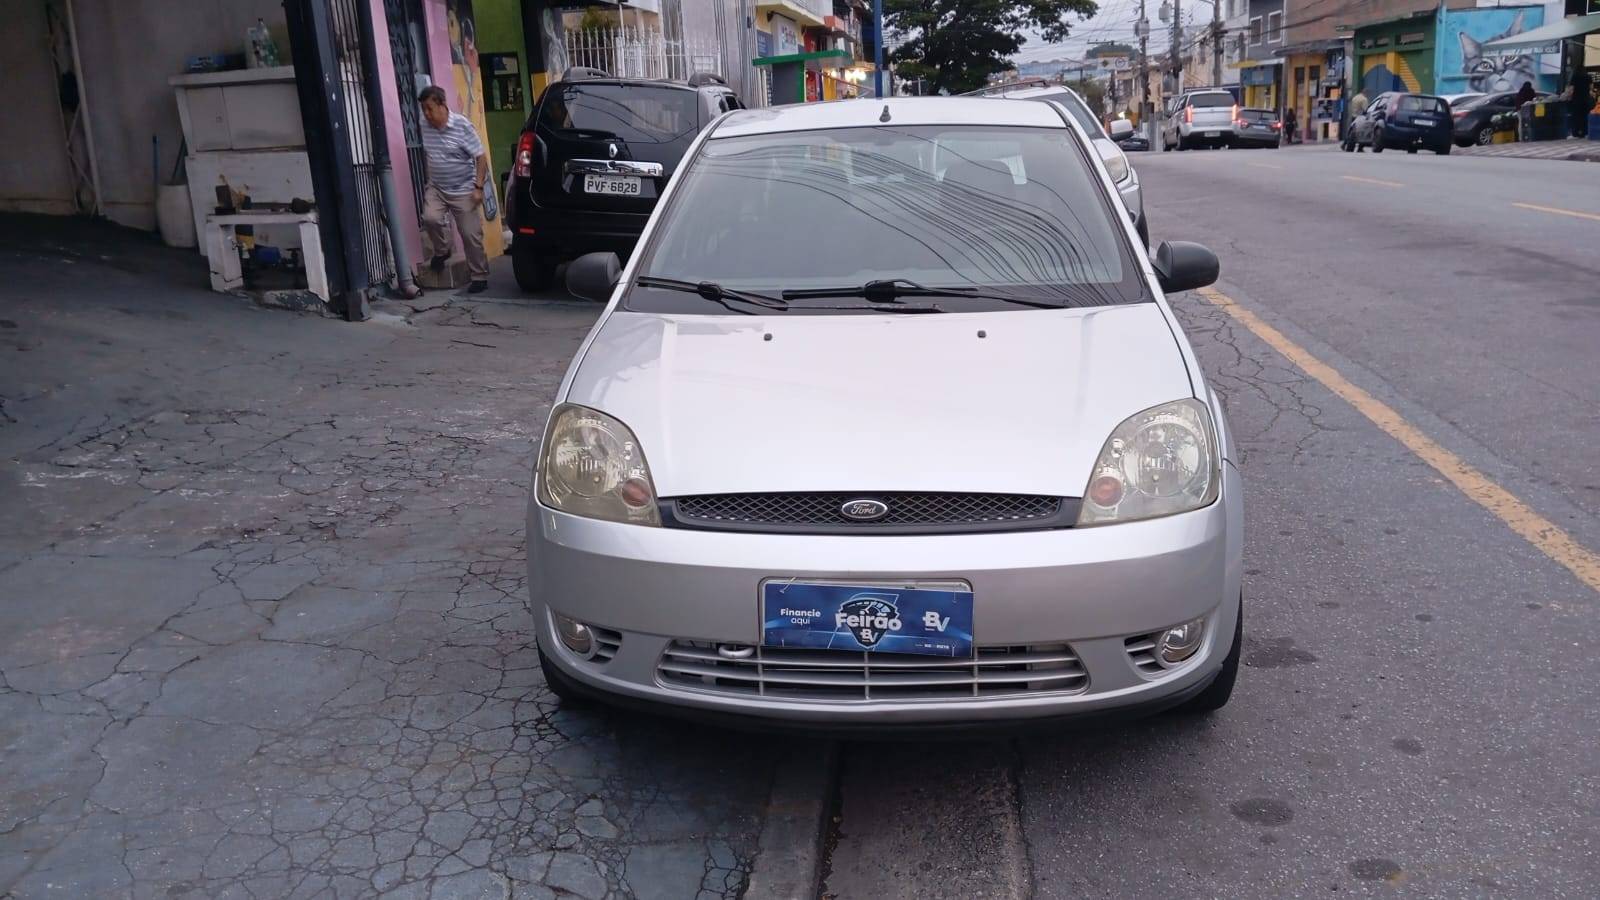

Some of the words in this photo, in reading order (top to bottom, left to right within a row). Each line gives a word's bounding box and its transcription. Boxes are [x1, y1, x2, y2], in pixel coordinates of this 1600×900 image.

[851, 503, 877, 514] Ford
[780, 608, 821, 618] Financie
[790, 617, 811, 626] aqui
[835, 611, 902, 631] Feirão
[922, 611, 950, 632] BV
